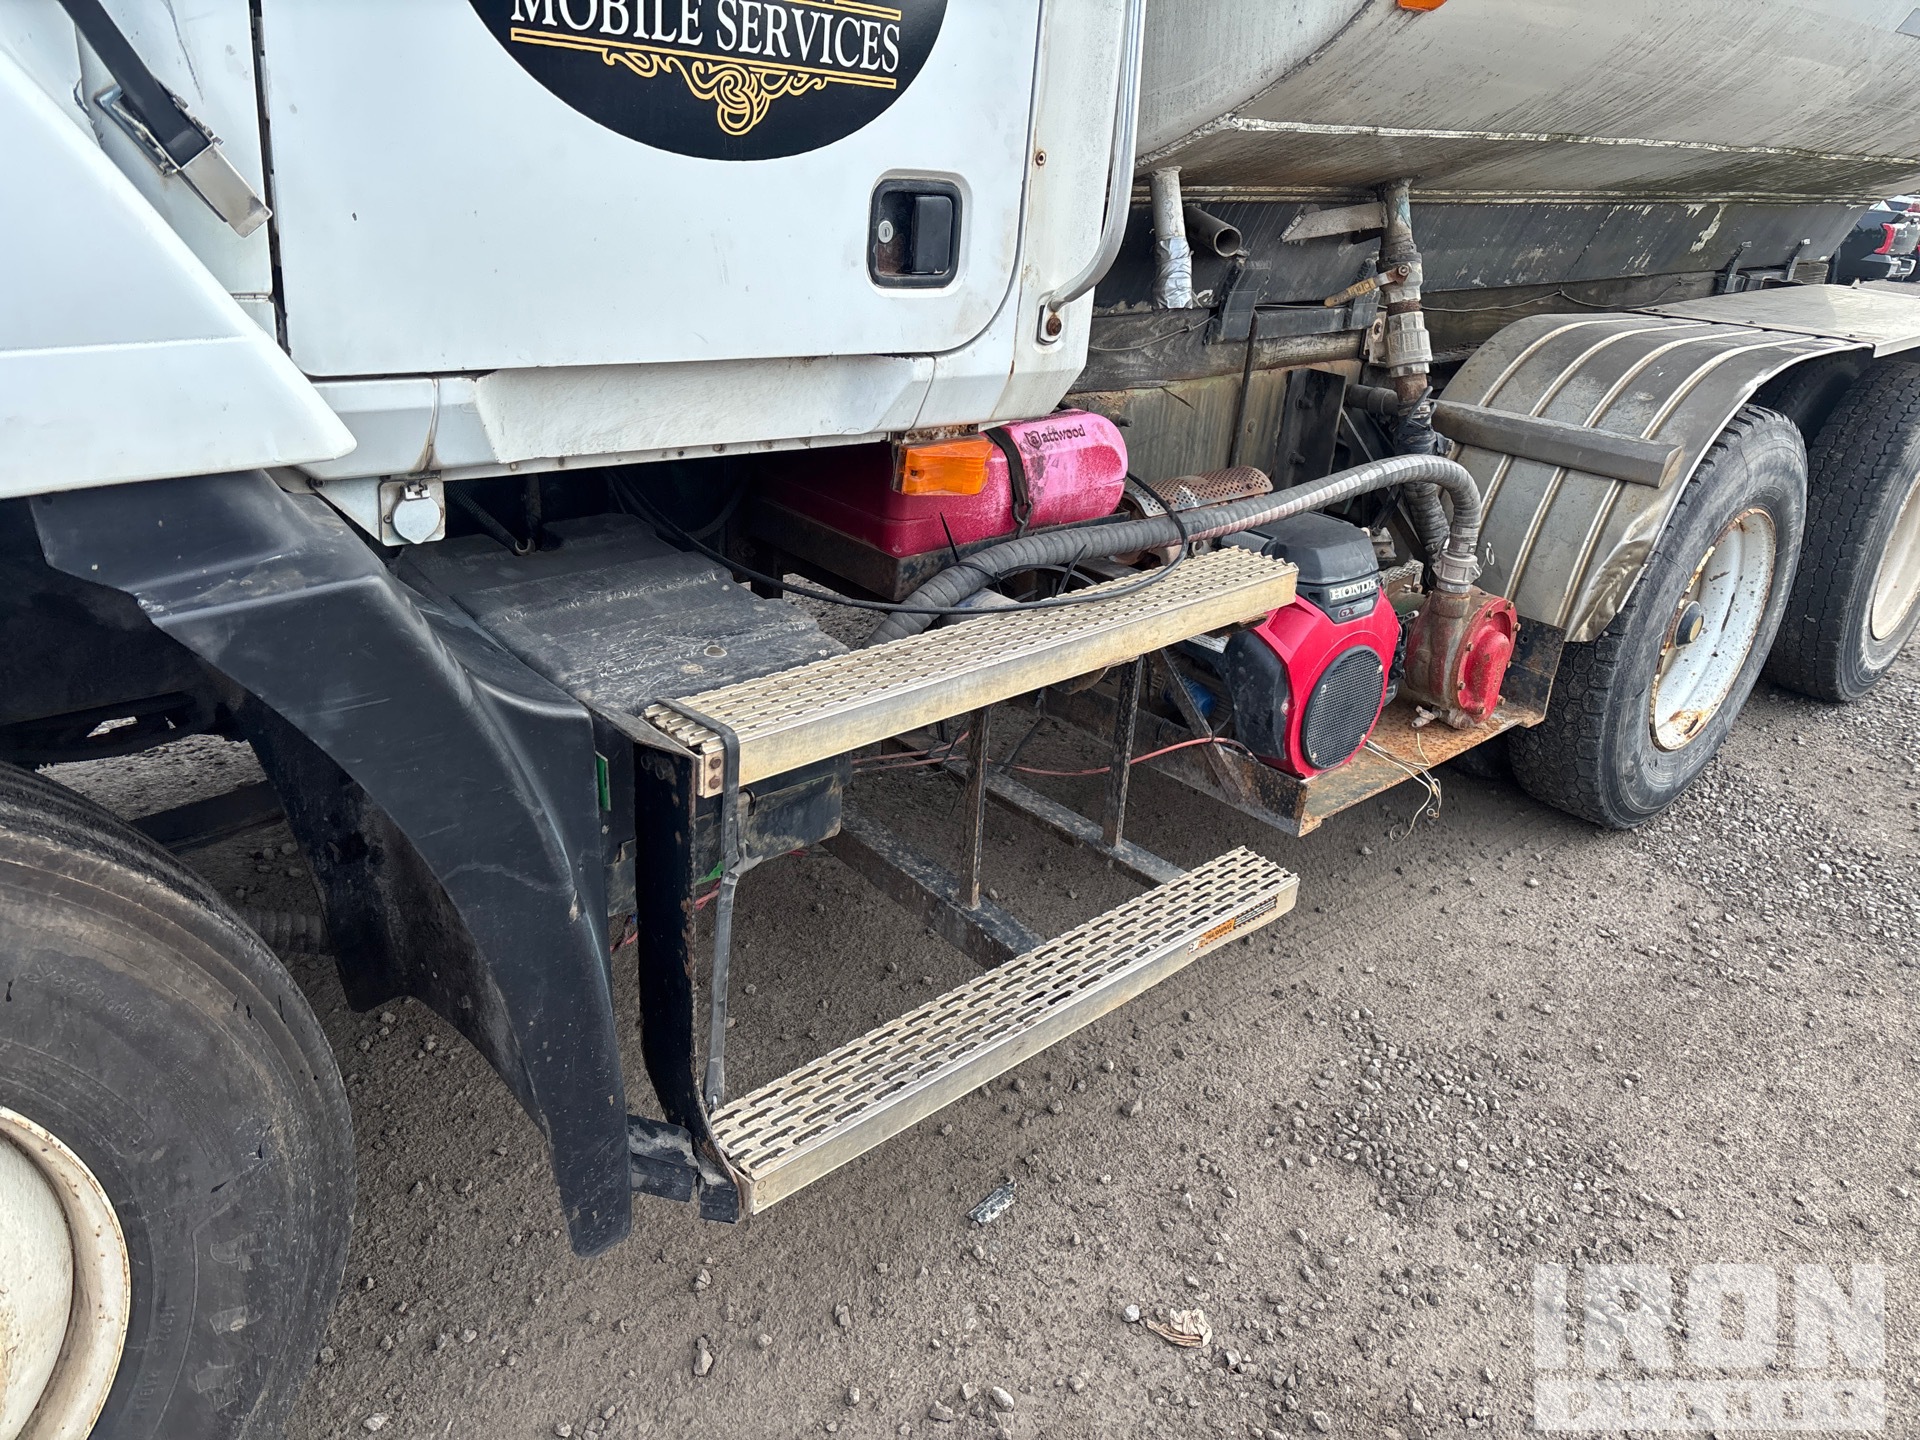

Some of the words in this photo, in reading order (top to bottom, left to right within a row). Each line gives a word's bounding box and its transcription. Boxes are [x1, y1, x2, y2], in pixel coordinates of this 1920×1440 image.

[511, 0, 703, 46] MOBILE
[717, 0, 900, 73] SERVICES
[1041, 424, 1086, 443] attwood
[1329, 579, 1378, 600] HONDA
[1340, 606, 1356, 618] GX
